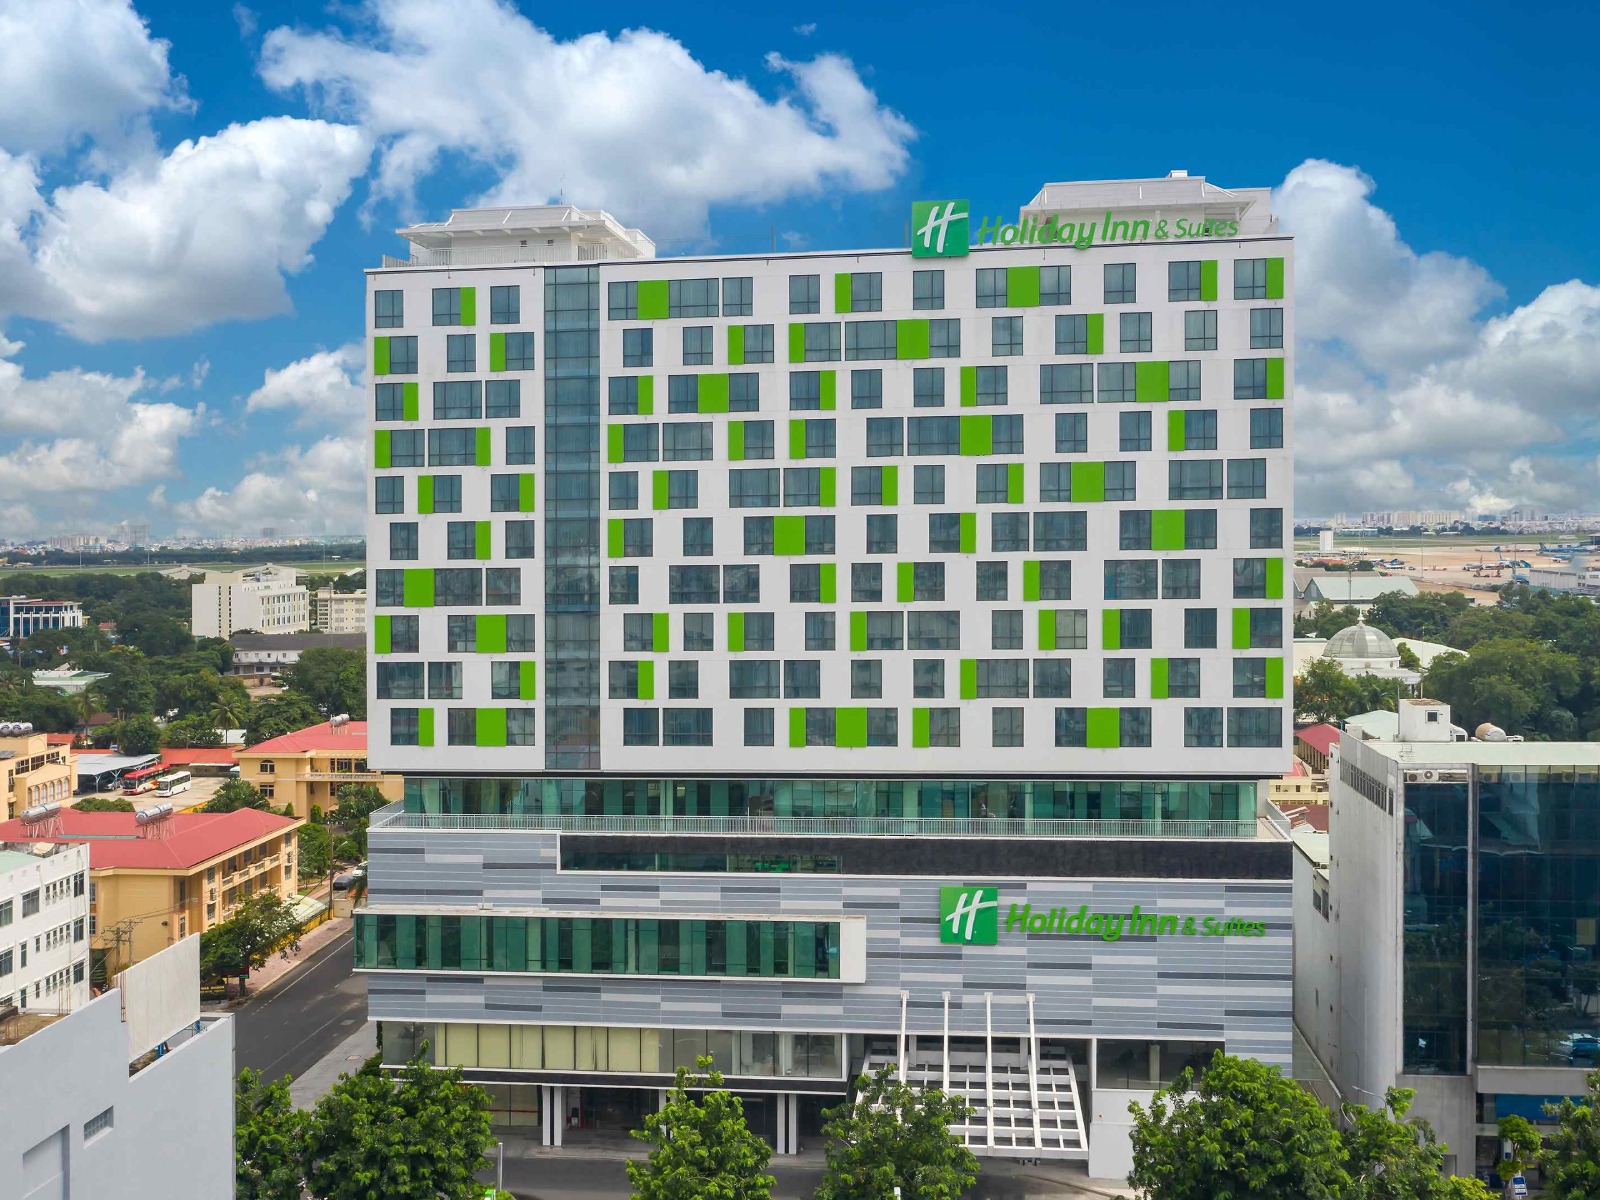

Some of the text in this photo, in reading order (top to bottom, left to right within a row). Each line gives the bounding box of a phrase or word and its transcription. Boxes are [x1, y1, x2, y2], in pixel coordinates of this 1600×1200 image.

[977, 210, 1239, 250] Holiday Inn & Suites
[1005, 903, 1266, 942] Holiday Inn & Suites
